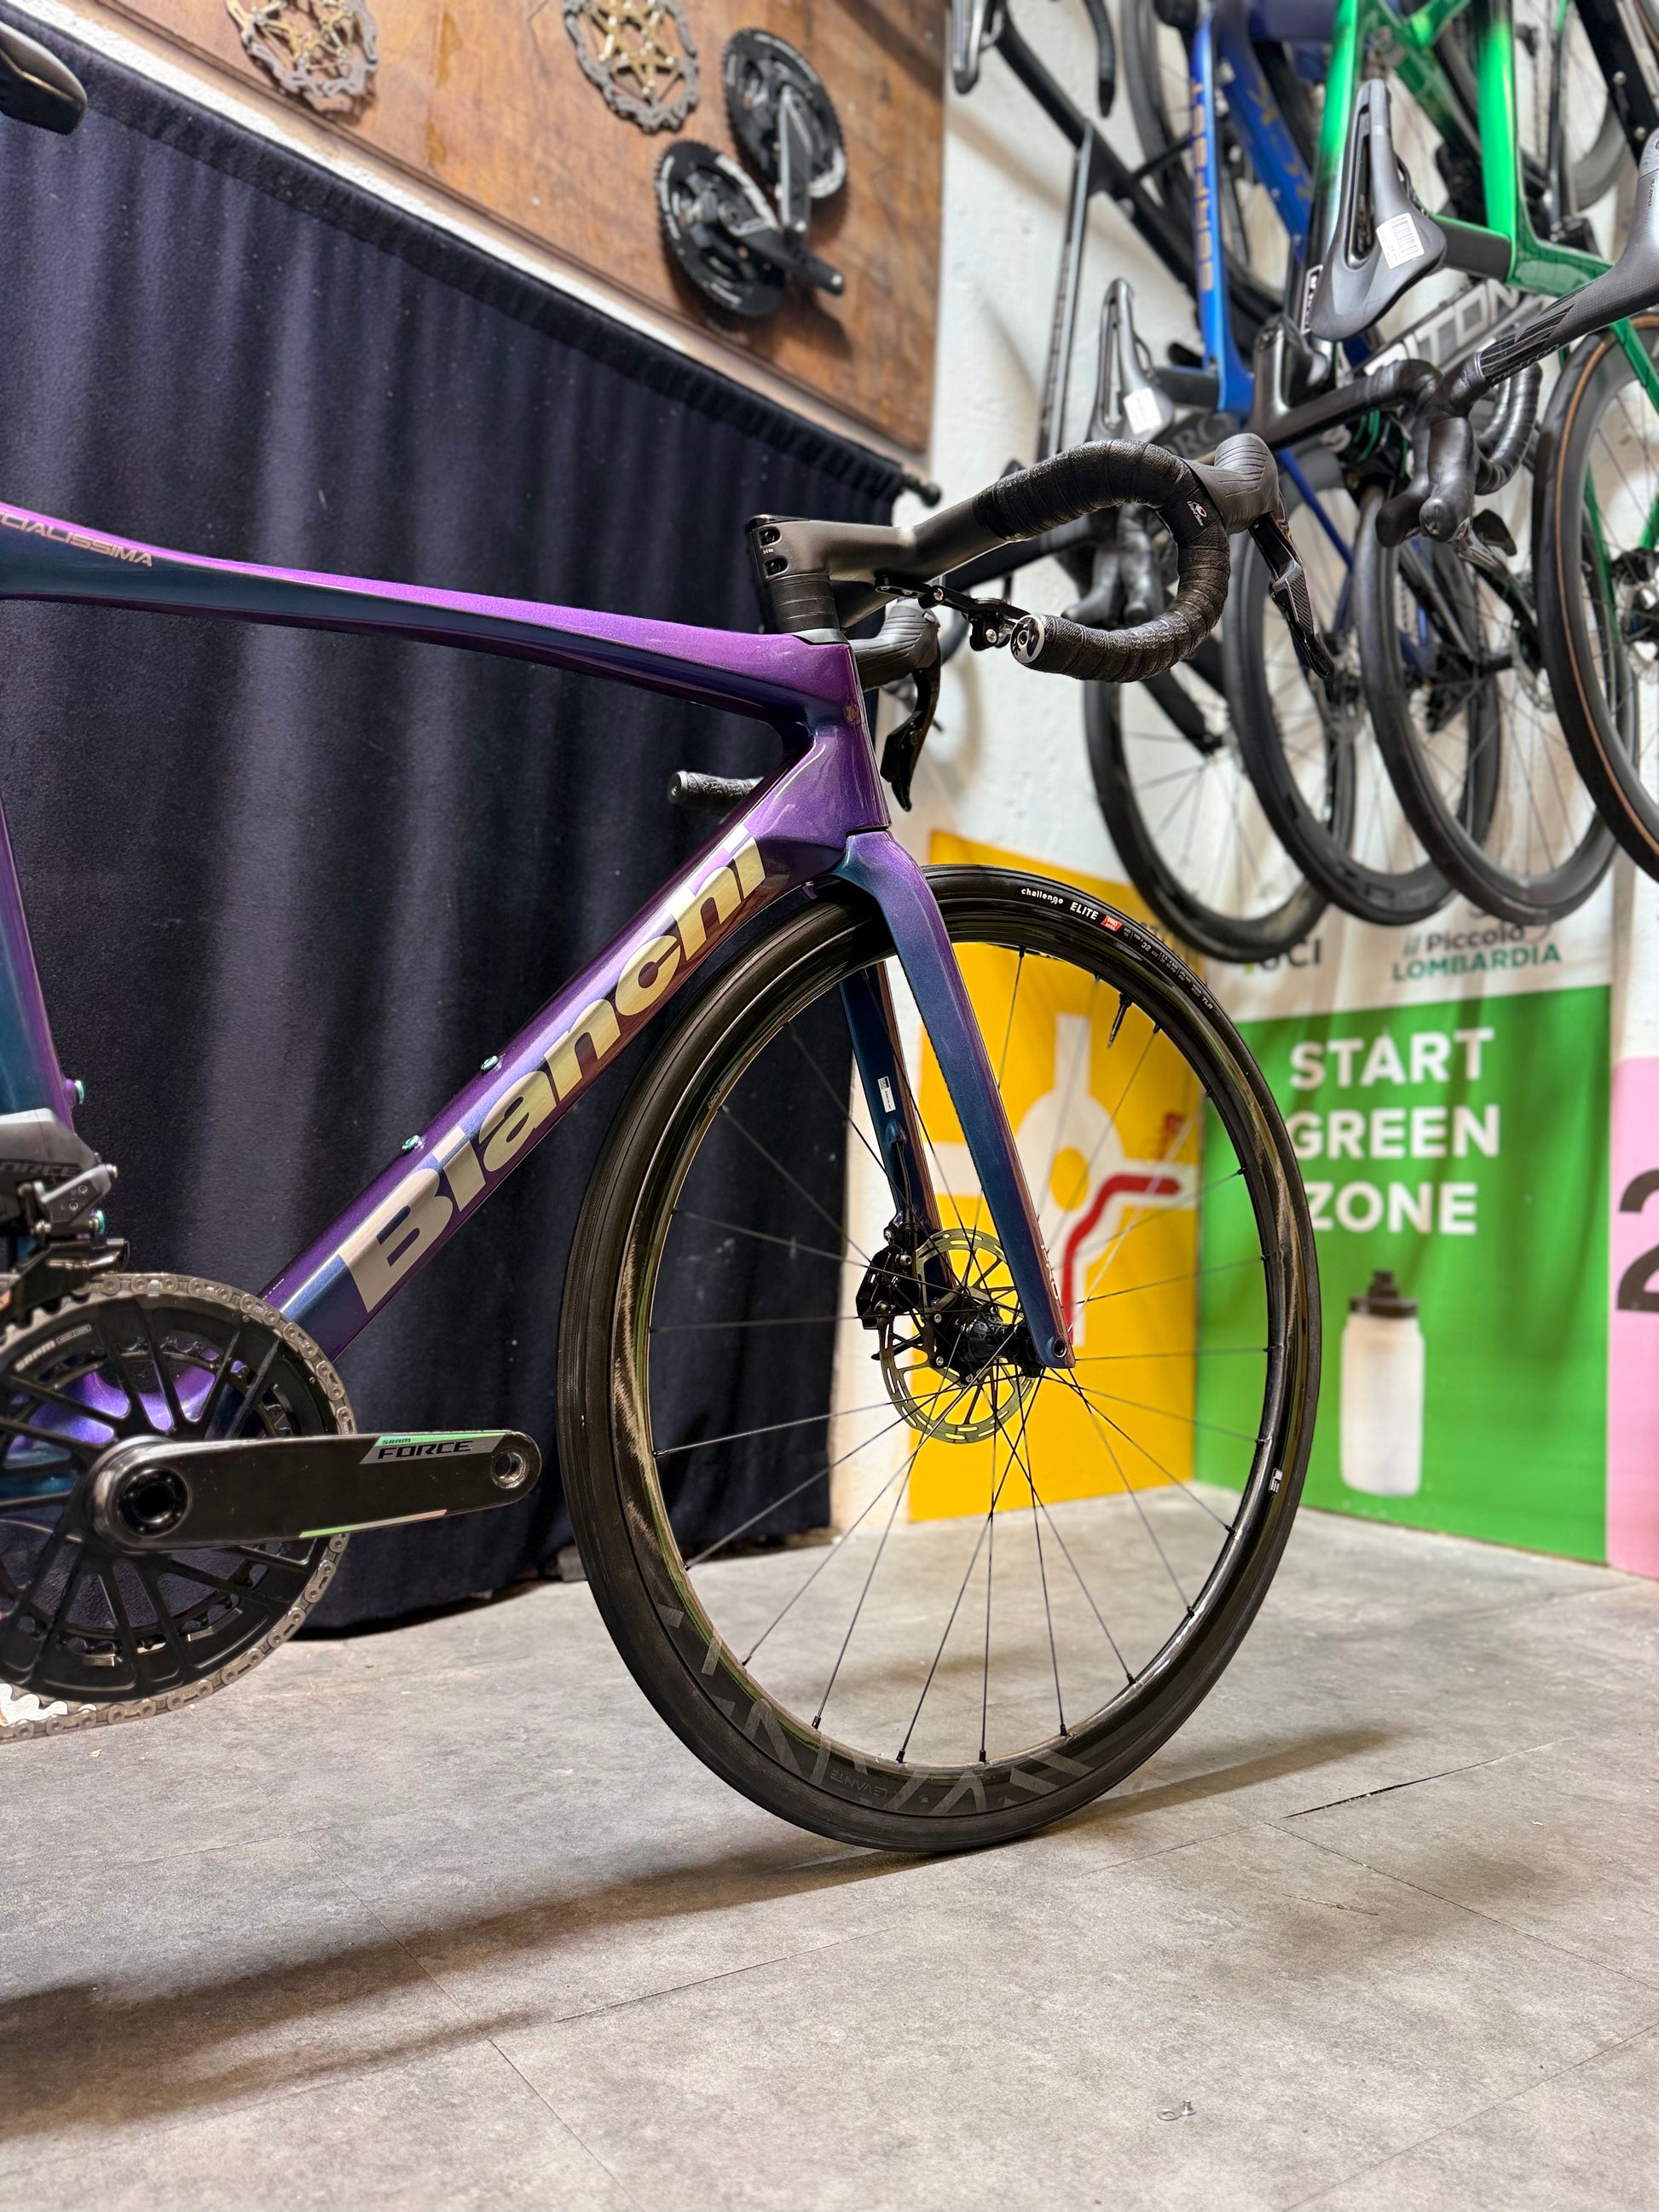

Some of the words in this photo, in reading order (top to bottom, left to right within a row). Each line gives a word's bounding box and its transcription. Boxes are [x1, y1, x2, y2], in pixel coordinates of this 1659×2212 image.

[0, 511, 153, 567] CIALISSIMA
[1020, 887, 1064, 905] challenge
[1069, 901, 1099, 921] ELITE
[1141, 941, 1152, 952] 32
[1426, 919, 1525, 951] Piccolo
[1392, 942, 1561, 983] LOMBARDIA
[336, 823, 766, 1314] Bianchi
[1290, 1027, 1495, 1090] START
[1285, 1104, 1500, 1161] GREEN
[1304, 1181, 1478, 1236] ZONE
[377, 1440, 474, 1459] FORCE
[830, 1768, 888, 1799] LEVANTE
